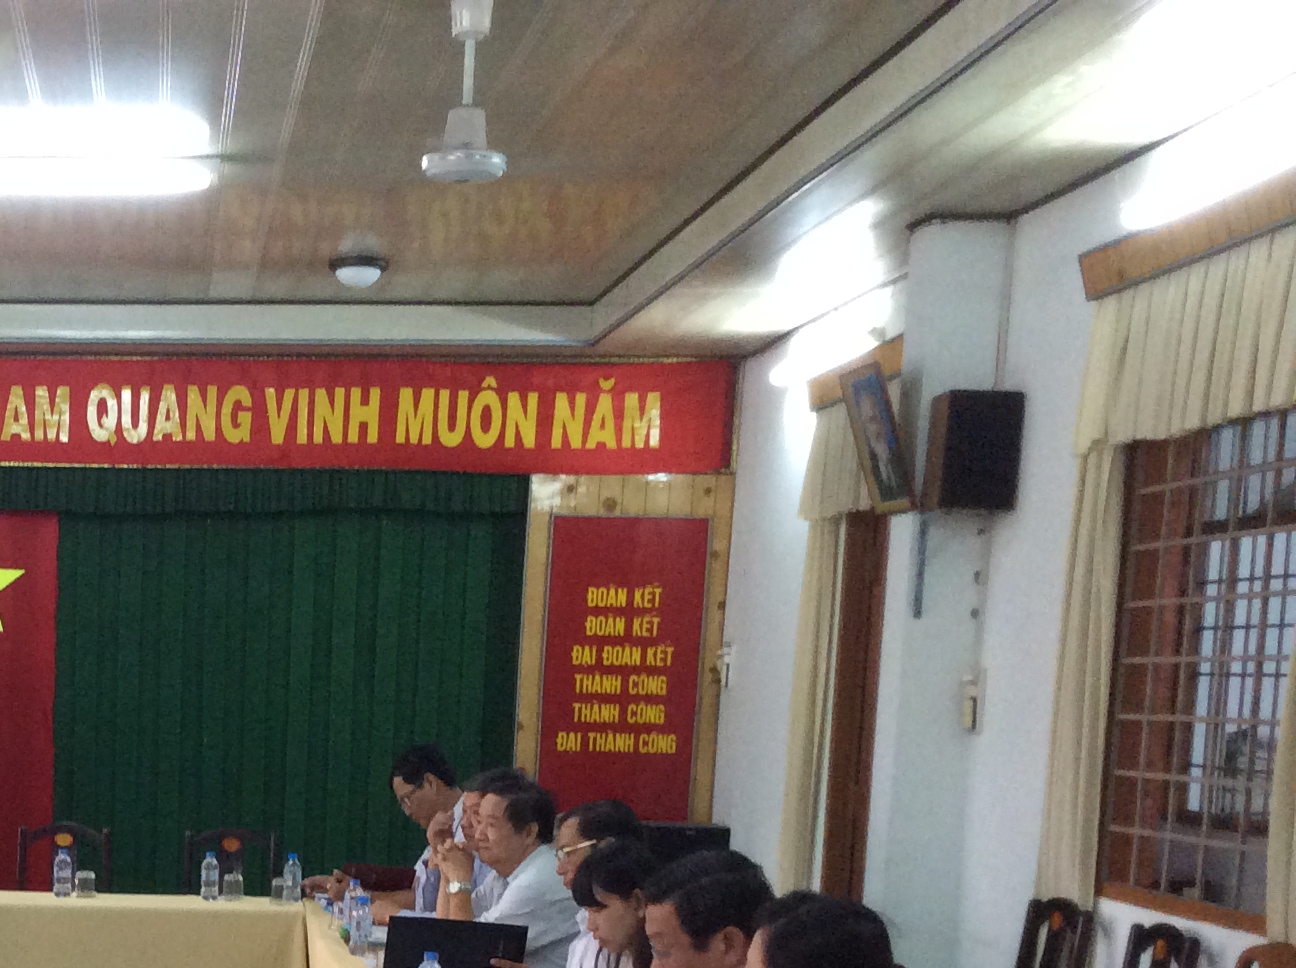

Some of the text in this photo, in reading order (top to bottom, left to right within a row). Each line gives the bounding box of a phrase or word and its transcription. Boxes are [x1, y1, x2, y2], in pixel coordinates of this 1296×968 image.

[86, 383, 252, 447] QUANG
[264, 386, 381, 445] VINH
[395, 375, 539, 449] MUÔN
[550, 377, 661, 450] NĂM
[586, 582, 663, 609] ĐOÀN KẾT
[584, 611, 661, 638] ĐOÀN KẾT
[571, 640, 675, 668] ĐẠI ĐOÀN KẾT
[574, 670, 667, 696] THÀNH CÔNG
[572, 699, 665, 725] THÀNH CÔNG
[556, 729, 677, 754] ĐẠI THÀNH CÔNG
